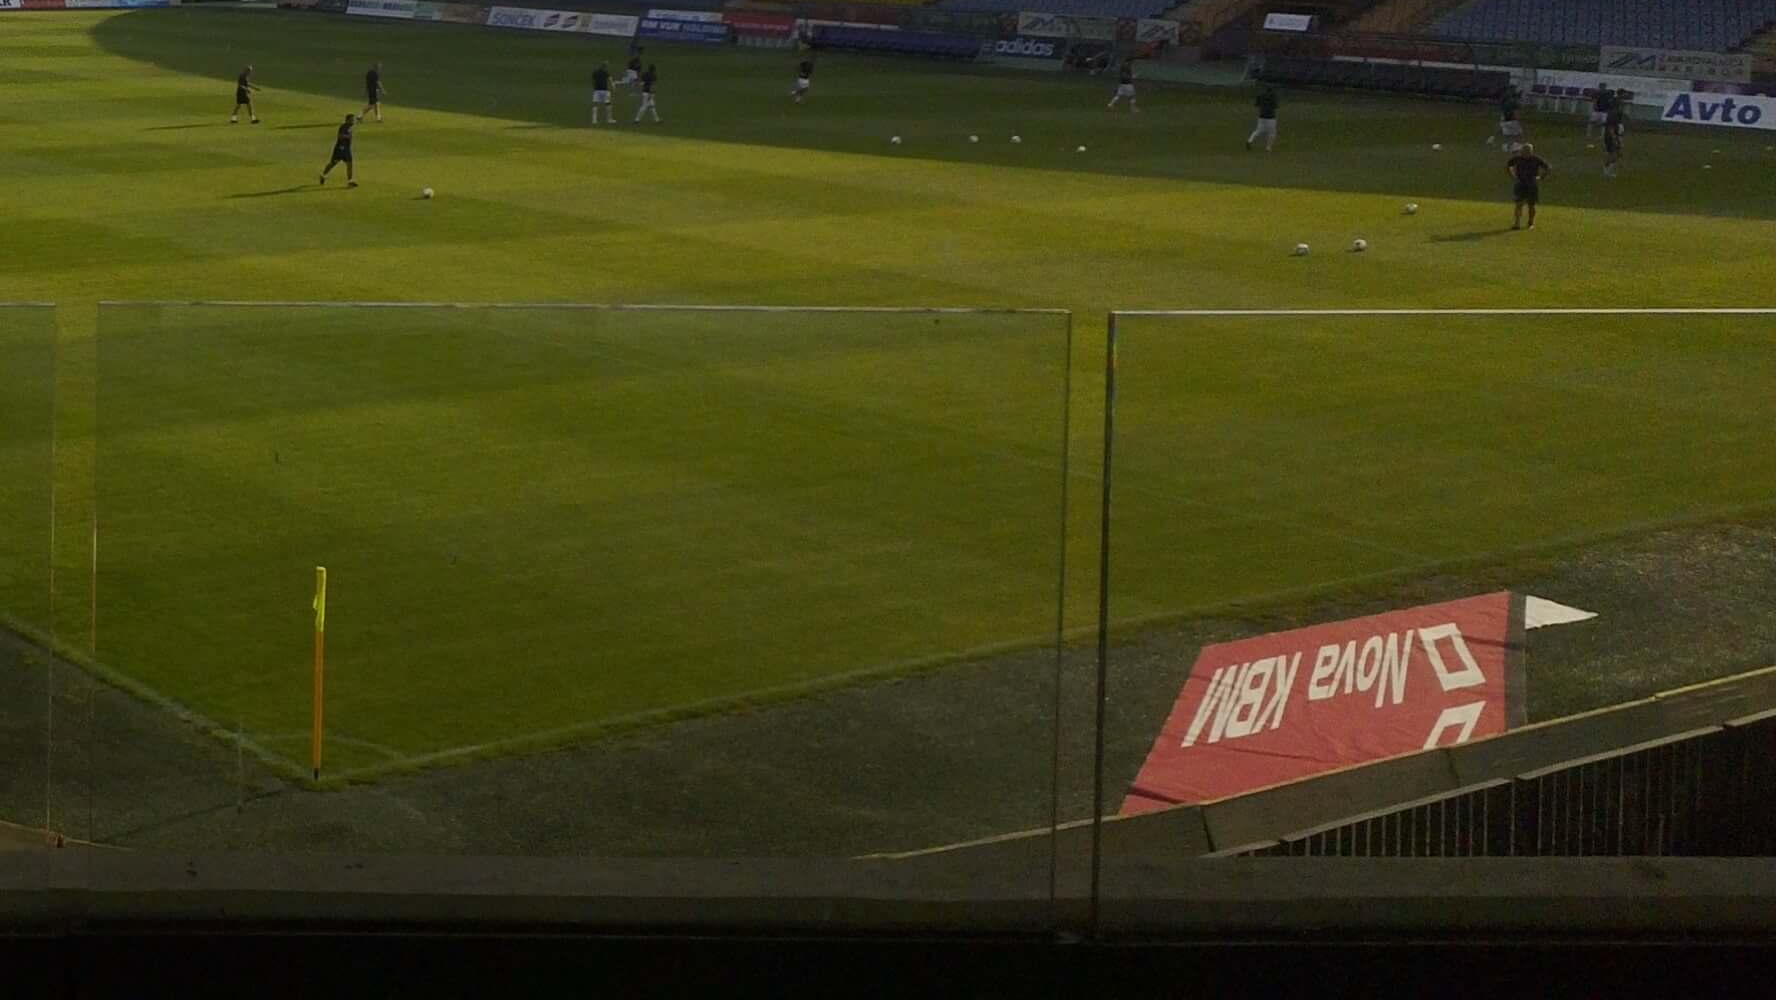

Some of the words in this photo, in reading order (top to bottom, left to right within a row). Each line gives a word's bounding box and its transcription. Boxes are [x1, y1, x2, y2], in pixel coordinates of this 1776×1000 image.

[995, 38, 1054, 56] adidas
[1665, 93, 1762, 125] Avto
[1308, 630, 1414, 709] Nova
[1181, 652, 1302, 748] KBM
